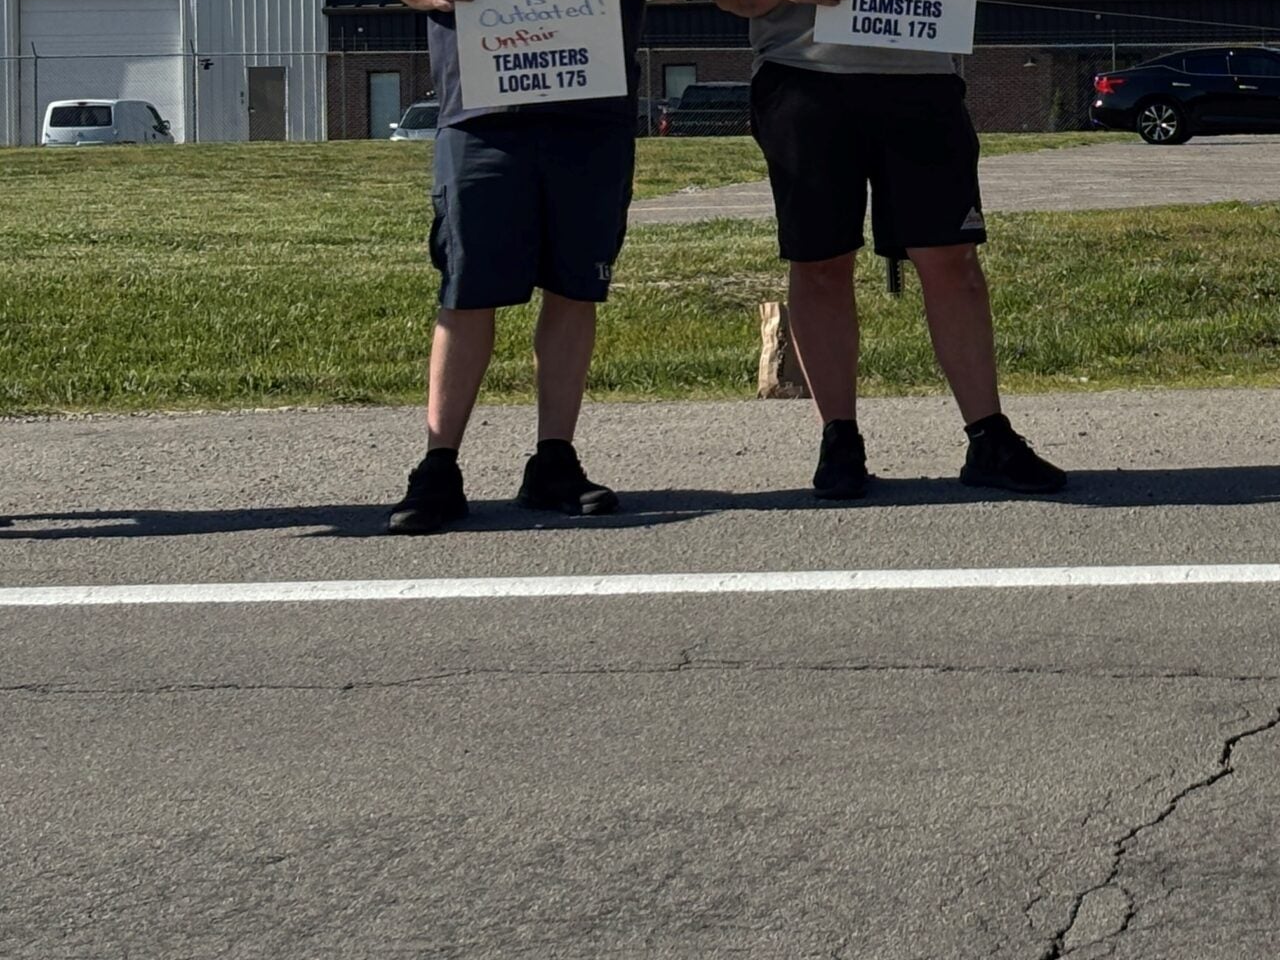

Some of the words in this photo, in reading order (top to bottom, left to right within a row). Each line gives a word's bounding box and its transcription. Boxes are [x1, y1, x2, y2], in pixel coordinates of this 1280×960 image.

[852, 15, 902, 37] LOCAL
[908, 21, 937, 39] 175
[481, 27, 559, 52] Unfair
[493, 48, 589, 72] TEAMSTERS
[499, 73, 551, 93] LOCAL
[556, 69, 587, 89] 175
